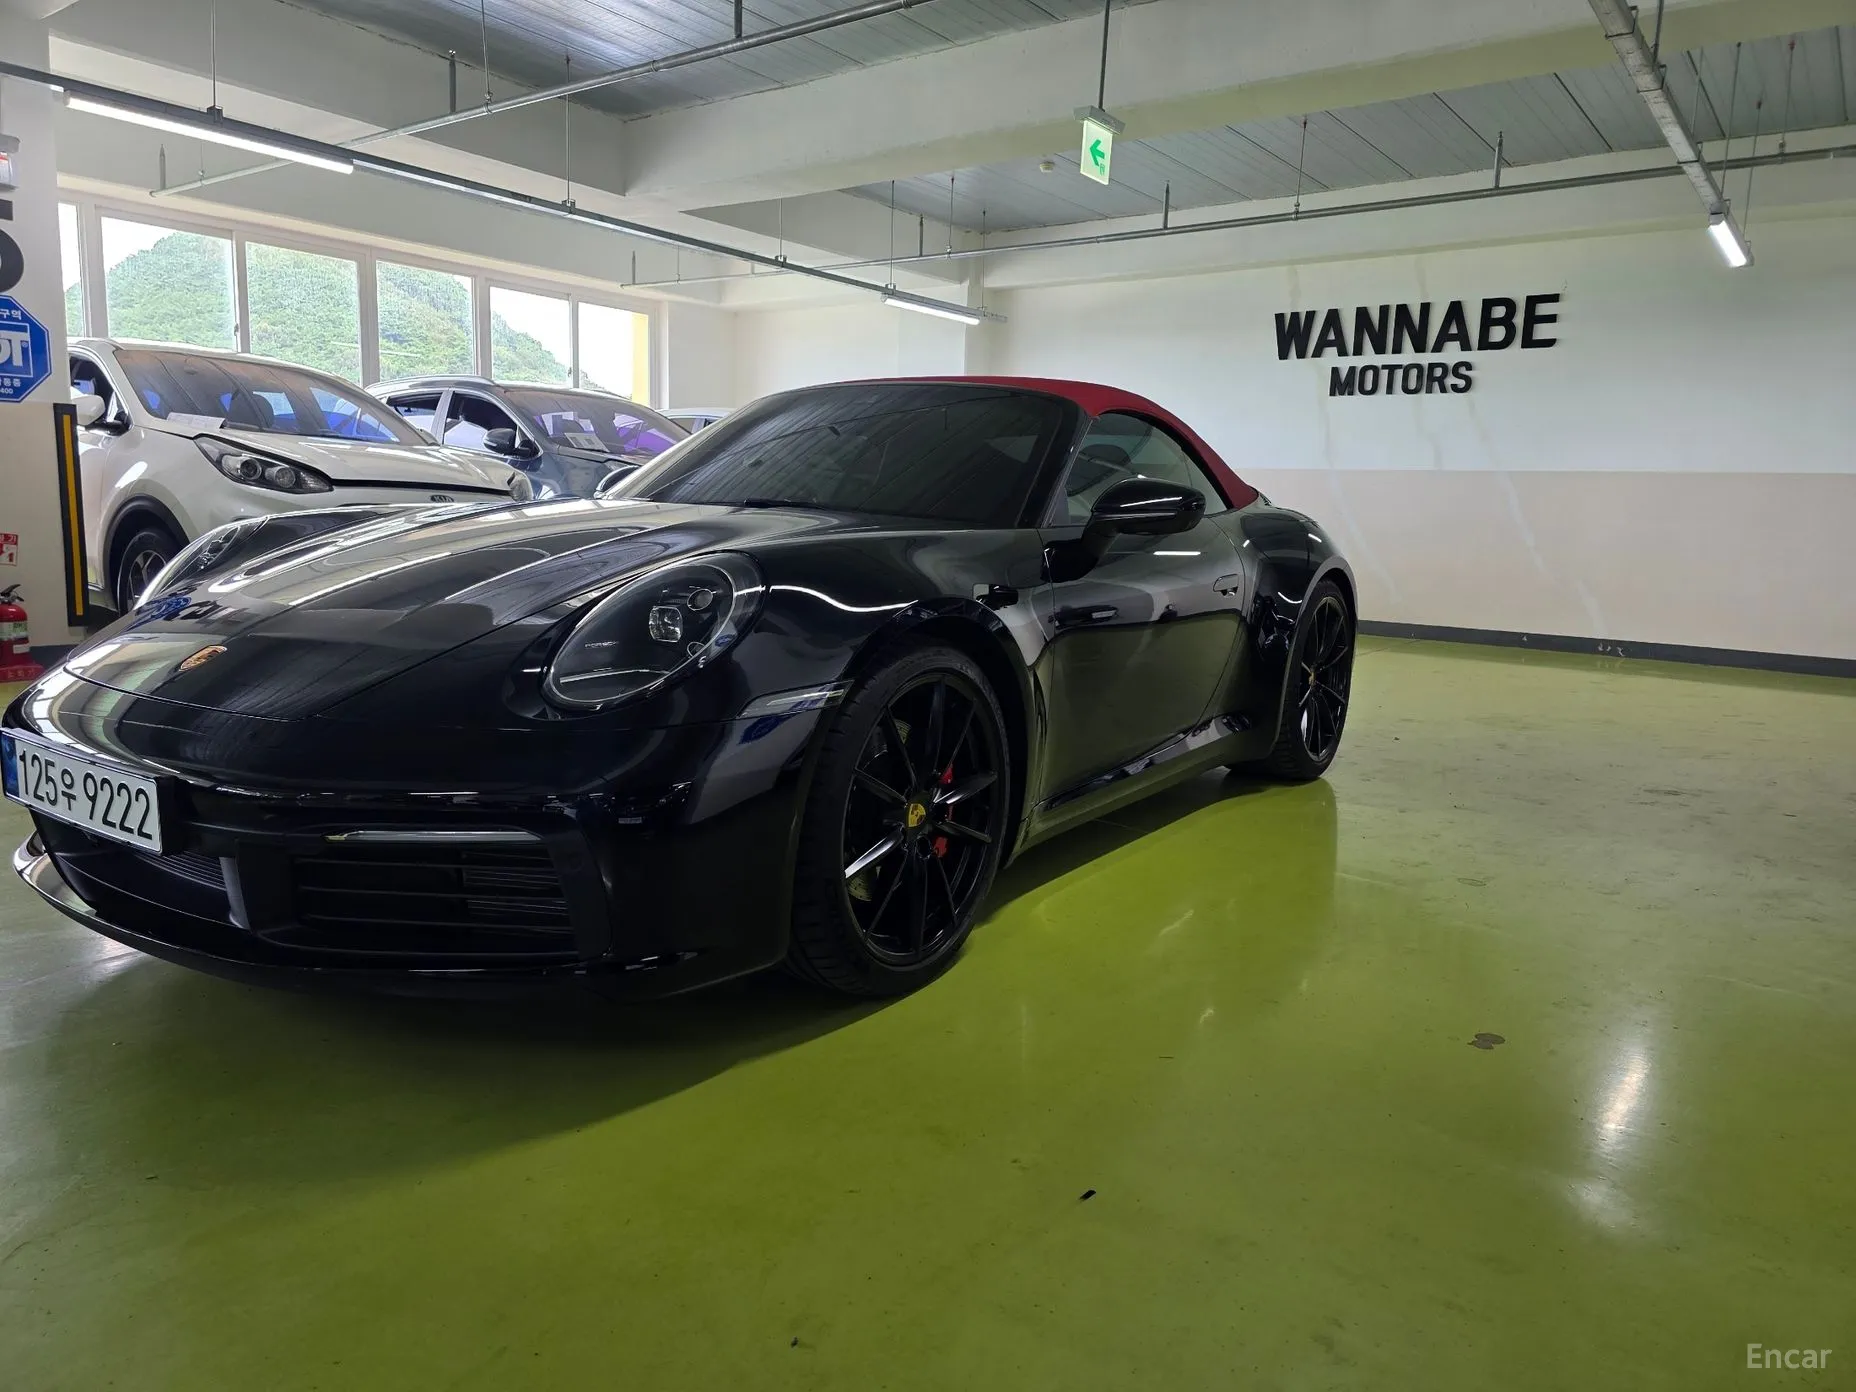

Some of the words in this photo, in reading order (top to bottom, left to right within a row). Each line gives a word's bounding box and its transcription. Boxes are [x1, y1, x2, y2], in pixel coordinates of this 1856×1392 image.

[1274, 293, 1561, 360] WANNABE
[1329, 361, 1473, 396] MOTORS
[19, 749, 76, 811] 125우
[83, 772, 153, 840] 9222
